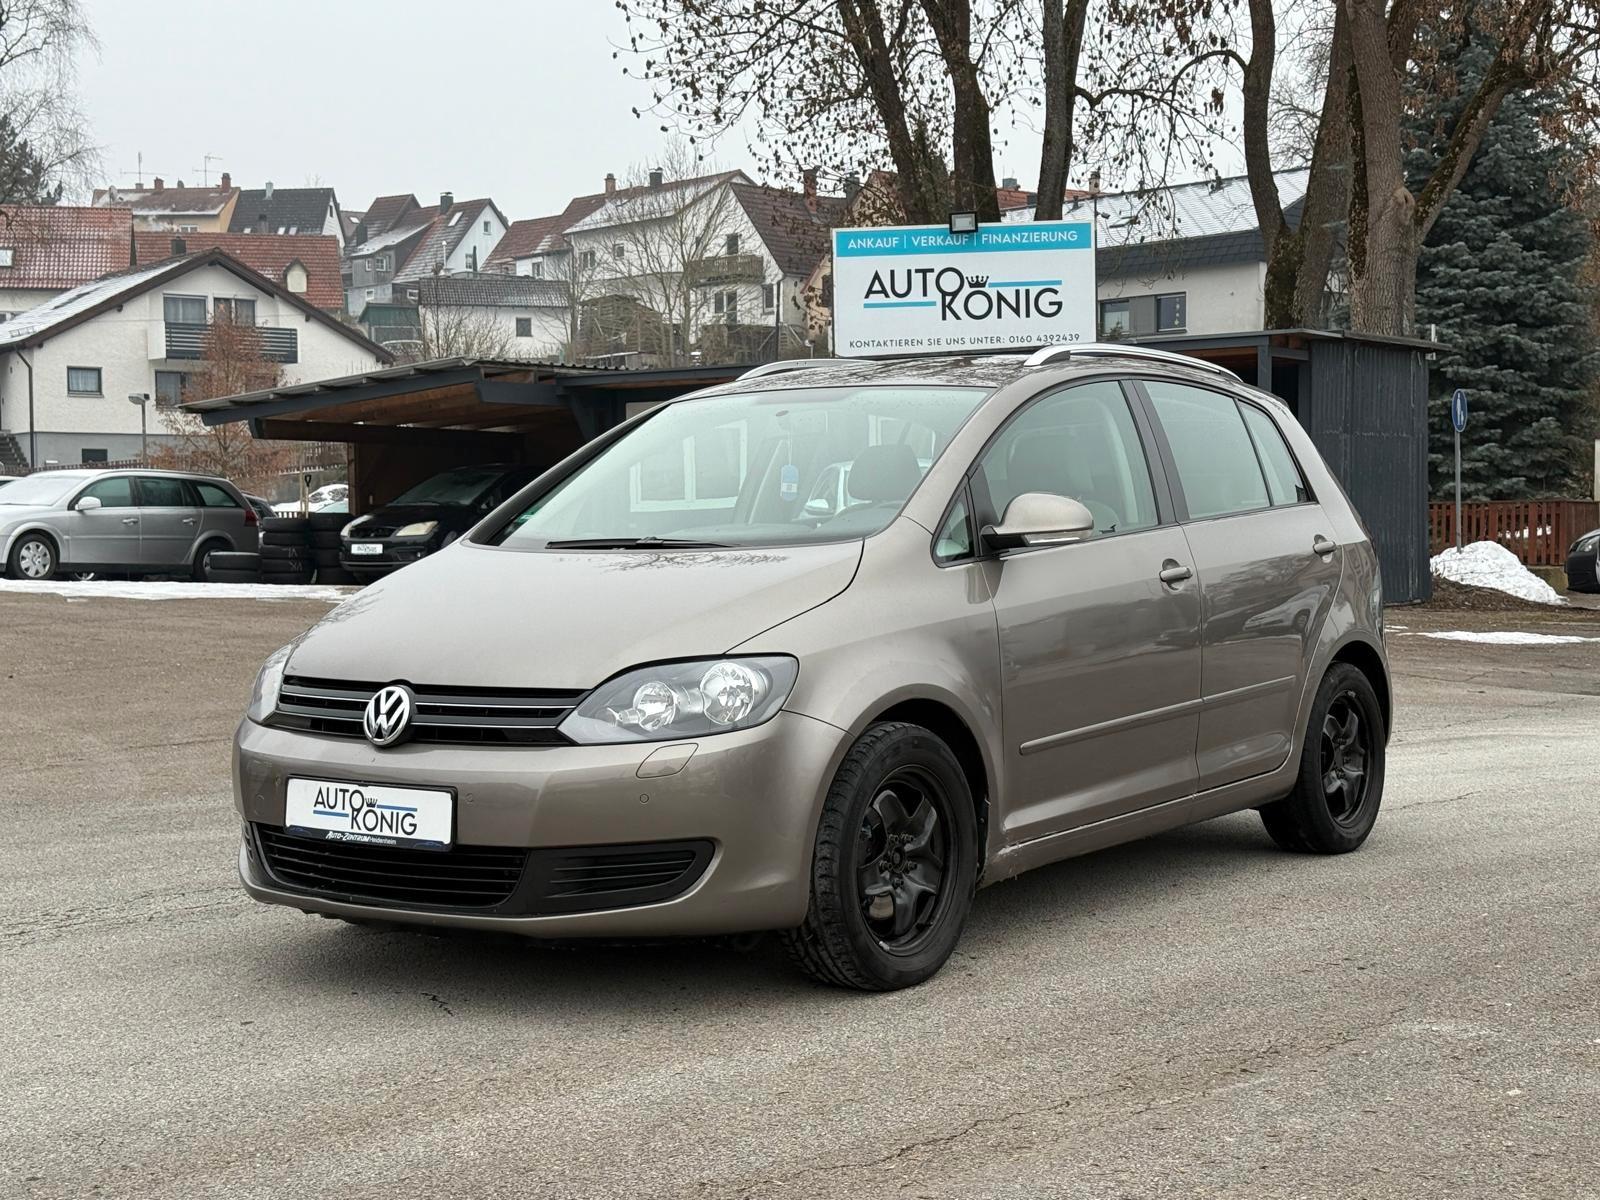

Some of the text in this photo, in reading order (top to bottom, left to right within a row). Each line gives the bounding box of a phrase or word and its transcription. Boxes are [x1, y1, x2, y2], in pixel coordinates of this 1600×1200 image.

[847, 230, 1078, 249] ANKAUF VERKAUF FINANZIERUNG
[864, 266, 965, 299] AUTO
[849, 333, 1080, 348] KONTAKTIEREN SIE UNS UNTER: 0160 4392439
[365, 686, 409, 744] VW
[313, 786, 365, 811] AUTO
